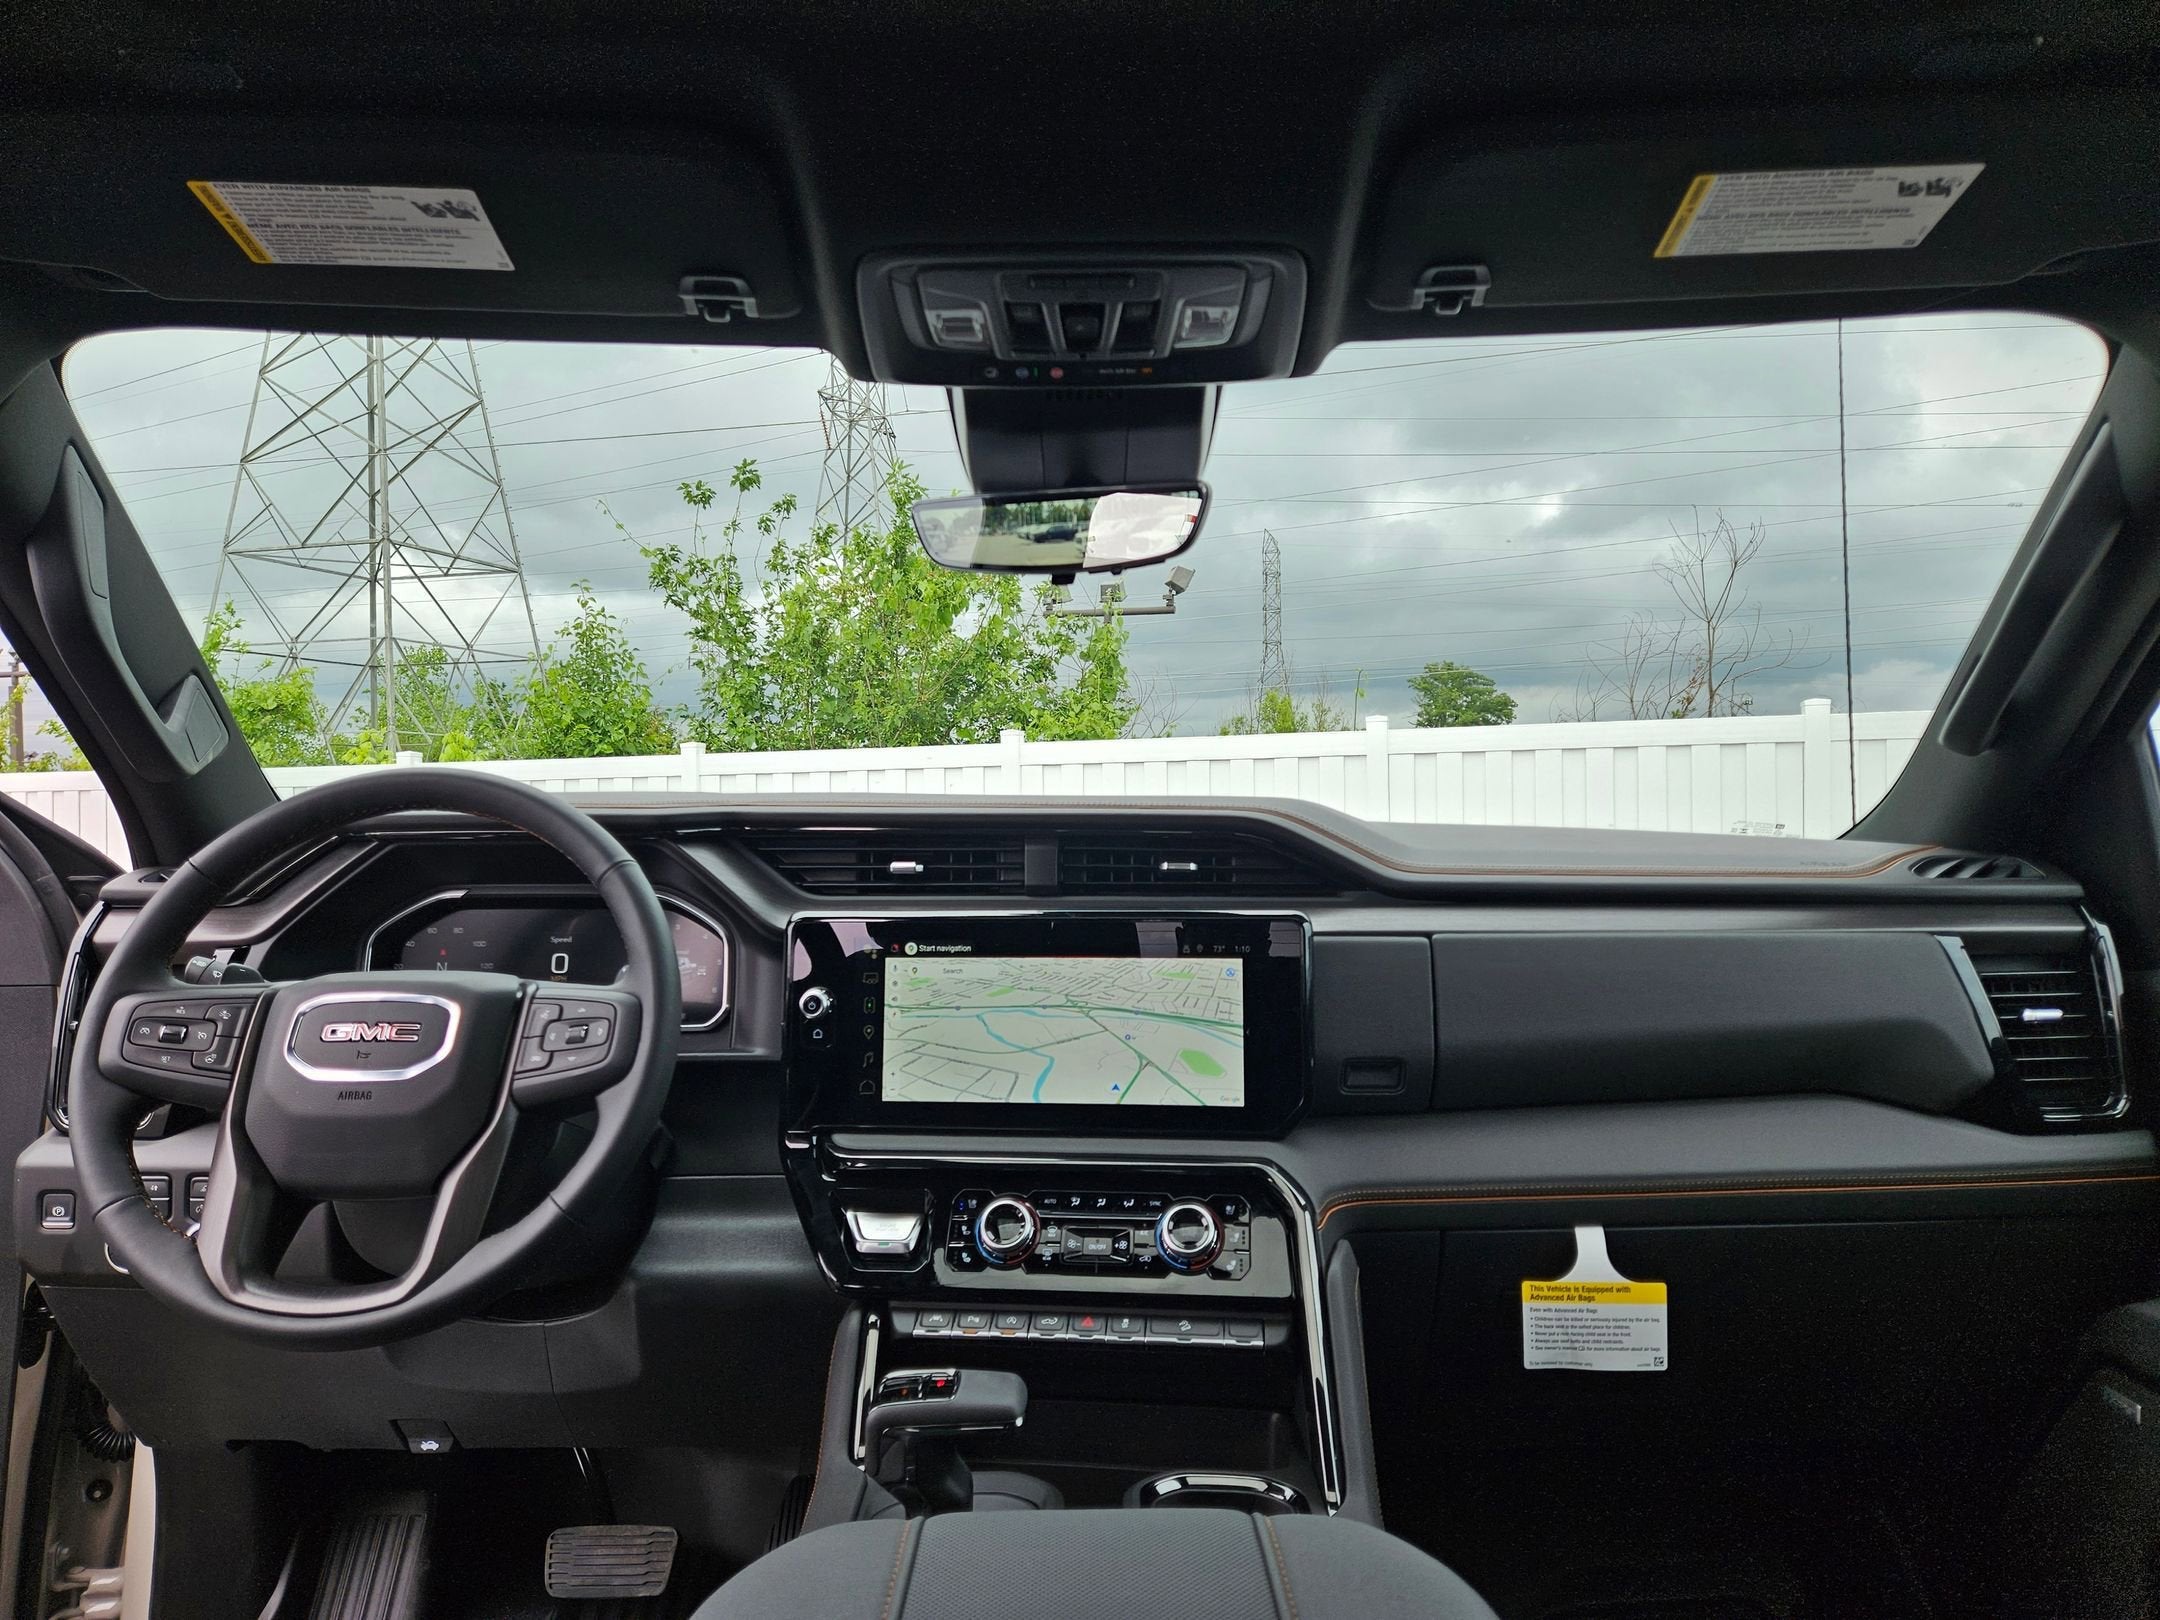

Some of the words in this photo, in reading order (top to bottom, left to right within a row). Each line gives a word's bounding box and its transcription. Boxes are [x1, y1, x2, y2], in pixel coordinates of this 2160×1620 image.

[550, 936, 573, 944] Speed
[919, 944, 935, 952] Start
[936, 944, 972, 954] navigation
[1235, 945, 1251, 953] 1:10
[436, 962, 448, 971] N
[551, 953, 570, 974] 0
[942, 967, 963, 975] Search
[321, 1023, 421, 1042] GMC
[337, 1090, 373, 1101] AIRBAG
[1530, 1284, 1544, 1292] This
[1582, 1285, 1614, 1295] Equipped
[1616, 1285, 1631, 1293] with
[1578, 1294, 1596, 1303] Bags
